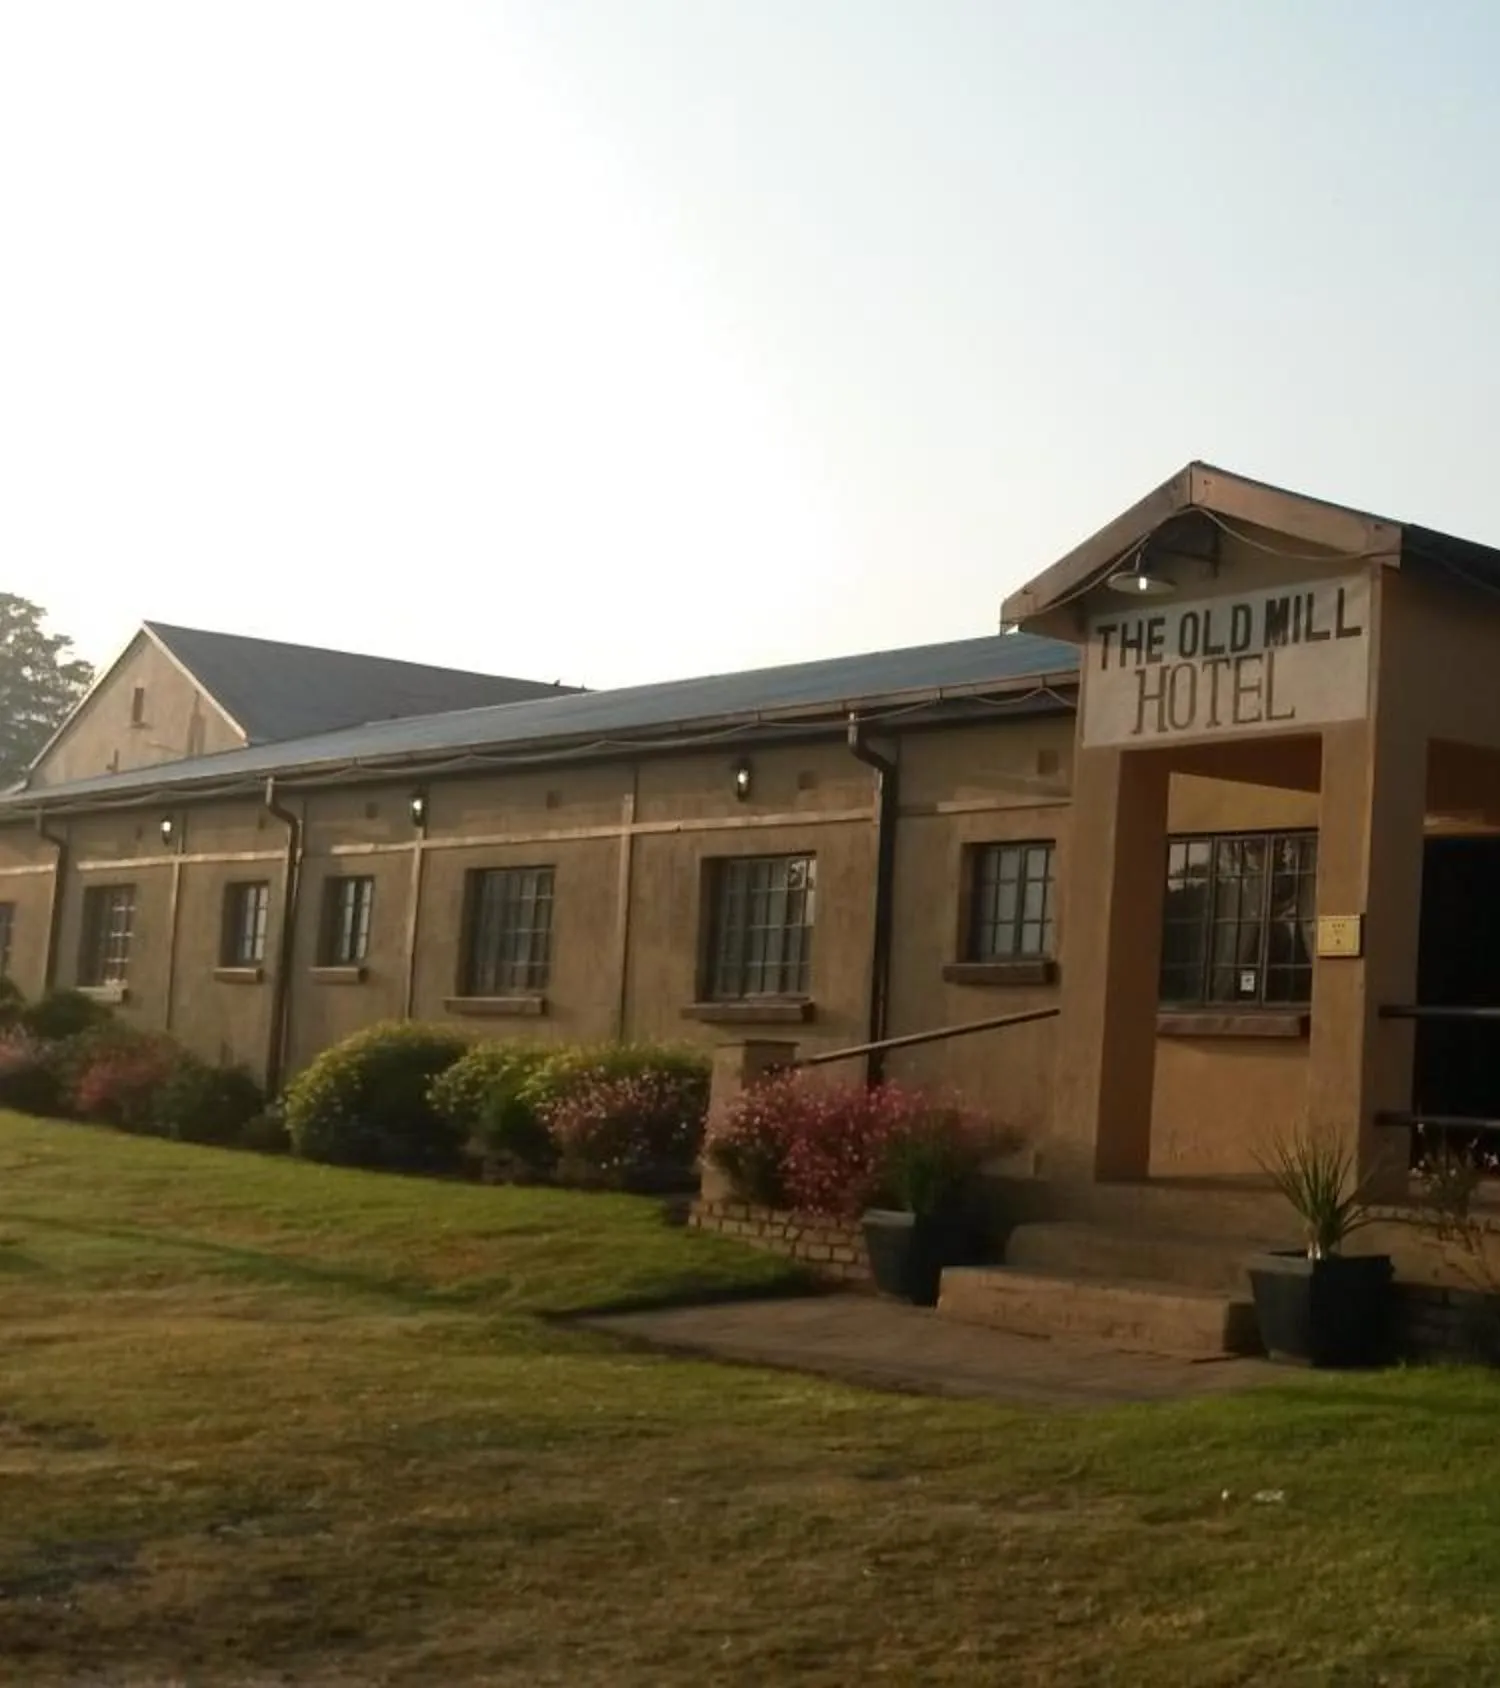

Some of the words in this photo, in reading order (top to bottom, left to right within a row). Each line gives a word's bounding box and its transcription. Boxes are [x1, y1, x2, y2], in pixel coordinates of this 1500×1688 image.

[1097, 617, 1165, 670] THE
[1179, 604, 1251, 657] OLD
[1263, 588, 1362, 648] MILL
[1132, 652, 1295, 735] HOTEL
